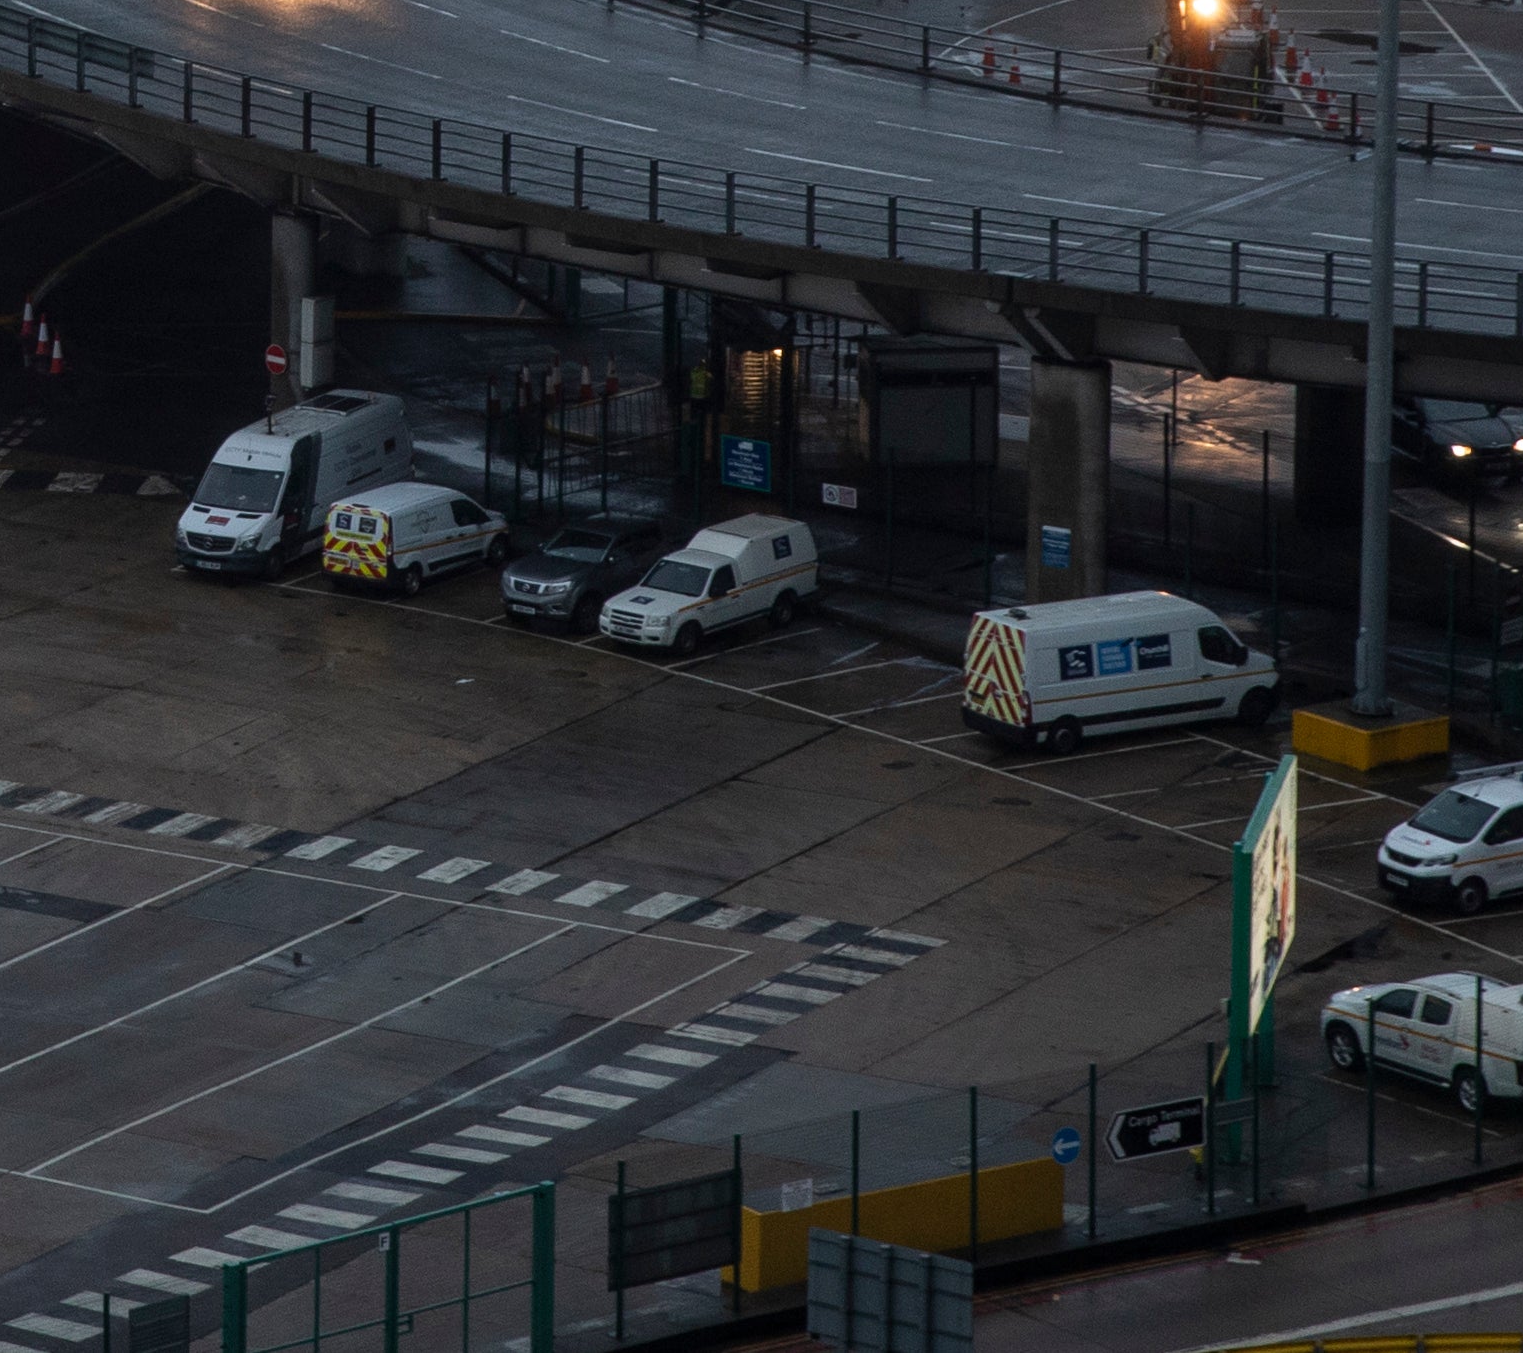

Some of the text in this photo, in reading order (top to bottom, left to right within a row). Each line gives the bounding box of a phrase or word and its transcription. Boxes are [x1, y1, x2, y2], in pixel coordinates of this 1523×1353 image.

[1127, 1105, 1201, 1128] Cargo Terminal
[381, 1234, 388, 1246] F
